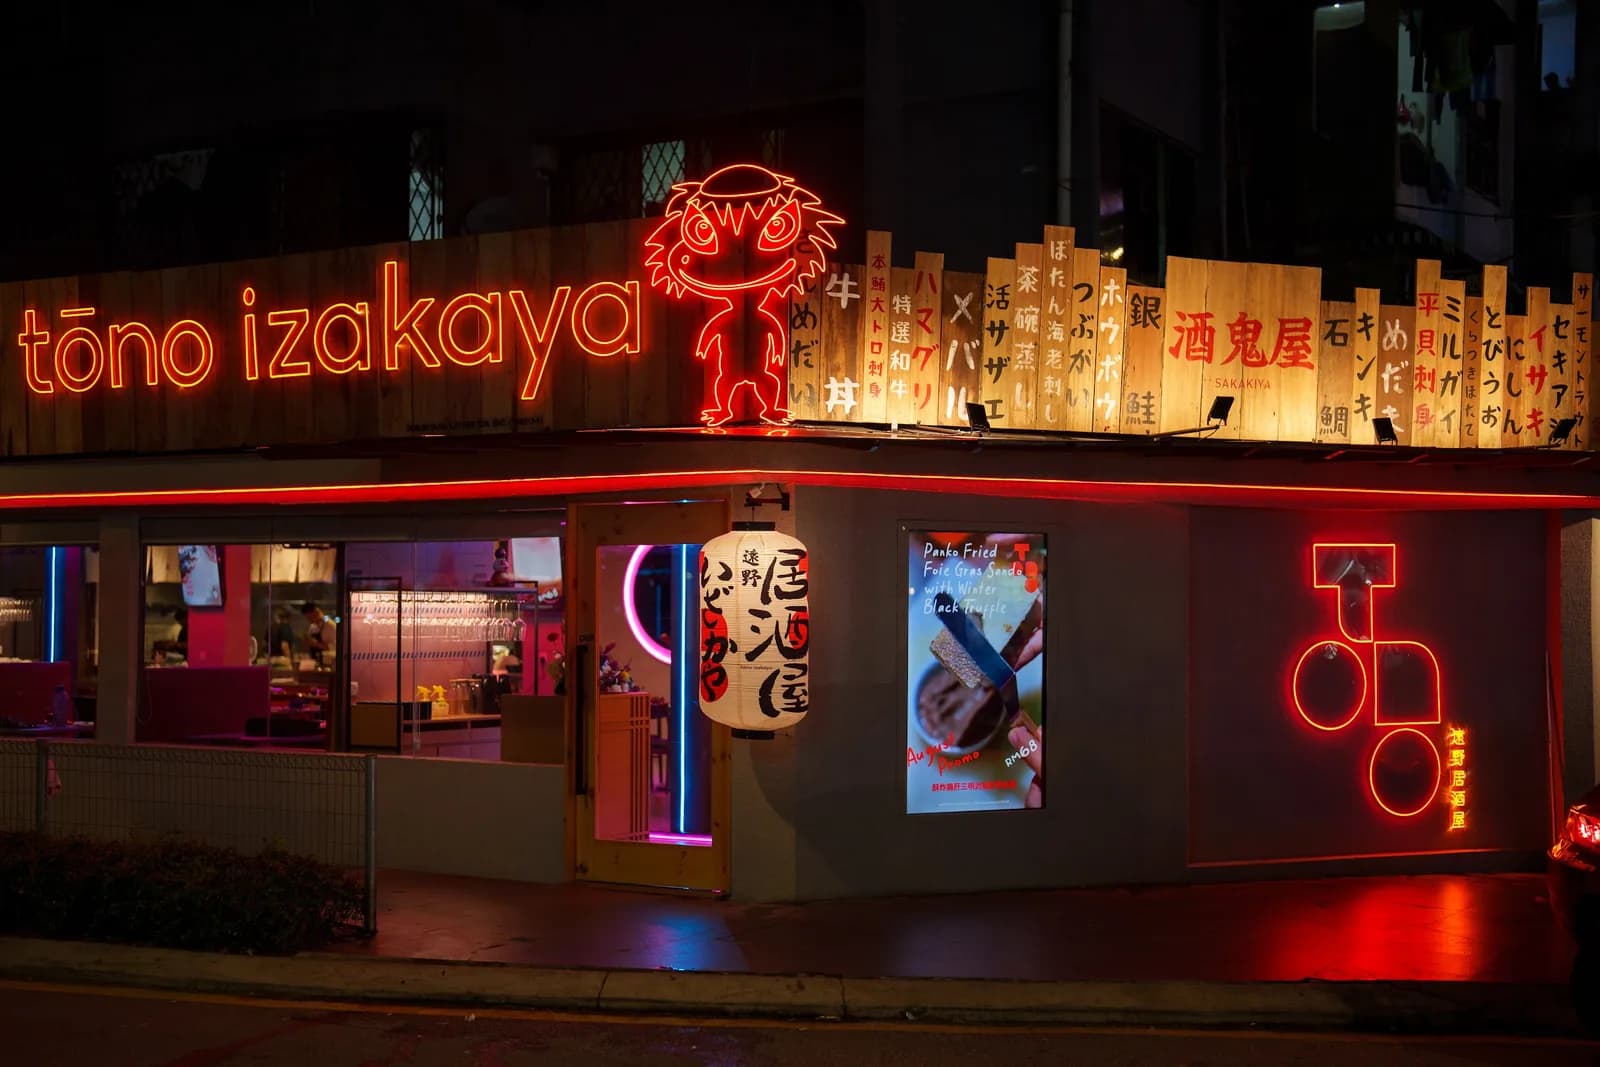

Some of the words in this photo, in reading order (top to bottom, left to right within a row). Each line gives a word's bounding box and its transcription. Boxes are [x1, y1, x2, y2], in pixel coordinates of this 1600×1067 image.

[242, 261, 641, 400] izakaya
[890, 294, 912, 398] 特選和牛
[912, 270, 940, 410] ハマグリ
[984, 283, 1011, 420] 活サザエ
[1014, 264, 1040, 410] 茶碗蒸し
[1044, 240, 1071, 423] ぼたん海老刺し
[1066, 282, 1094, 409] つぶがい
[1096, 278, 1123, 421] ホウボウ
[1168, 310, 1315, 371] 酒鬼屋
[1215, 377, 1271, 390] SAKAKIYA
[1354, 312, 1376, 422] キンキ
[1414, 292, 1440, 431] 平貝刺身
[1440, 295, 1463, 434] ミルガイ
[1481, 306, 1504, 428] とびうお
[1503, 335, 1525, 435] にしん
[1526, 325, 1548, 437] イサキ
[1574, 284, 1589, 447] サーモントラウト
[741, 549, 762, 587] 遠野
[923, 542, 959, 559] Panko
[963, 542, 998, 560] Fried
[923, 561, 950, 578] Foie
[955, 562, 982, 577] Gras
[986, 561, 1023, 578] Sando
[923, 598, 959, 615] Black
[963, 598, 1007, 620] Truffle
[924, 580, 953, 595] with
[957, 581, 997, 596] Winter
[745, 548, 808, 717] 居酒屋
[1004, 739, 1039, 768] RM68
